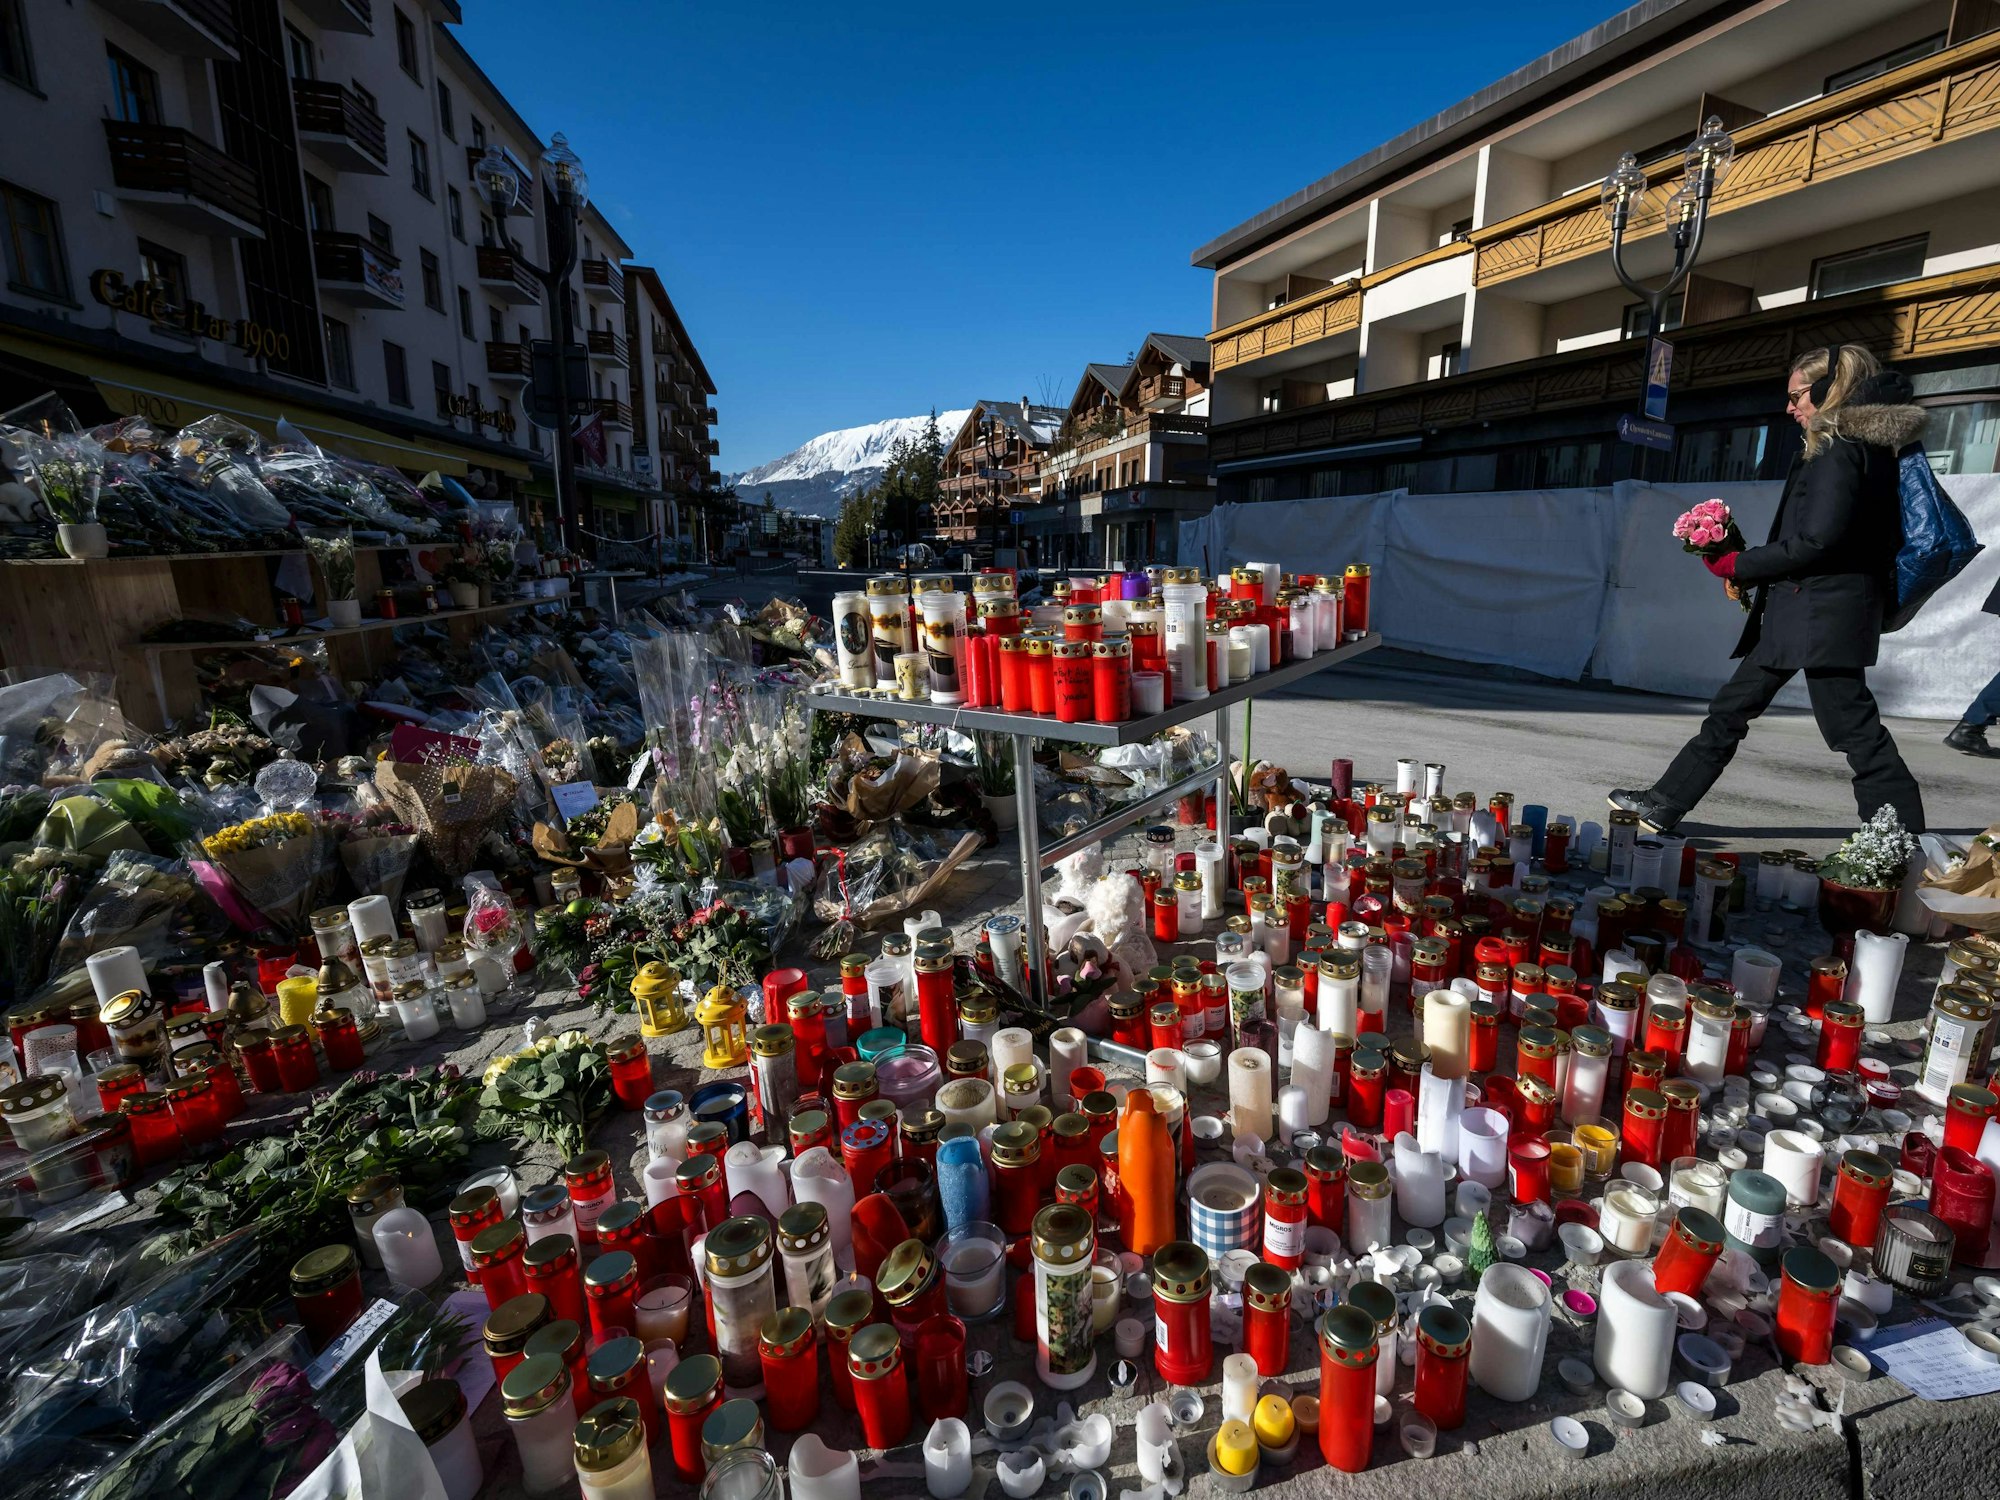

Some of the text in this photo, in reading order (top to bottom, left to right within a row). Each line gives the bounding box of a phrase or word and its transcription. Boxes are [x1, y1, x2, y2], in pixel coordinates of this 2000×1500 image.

[242, 320, 290, 361] 1900
[131, 392, 178, 424] 1900
[580, 1200, 604, 1209] MIGROS
[1269, 1221, 1292, 1232] MIGROS
